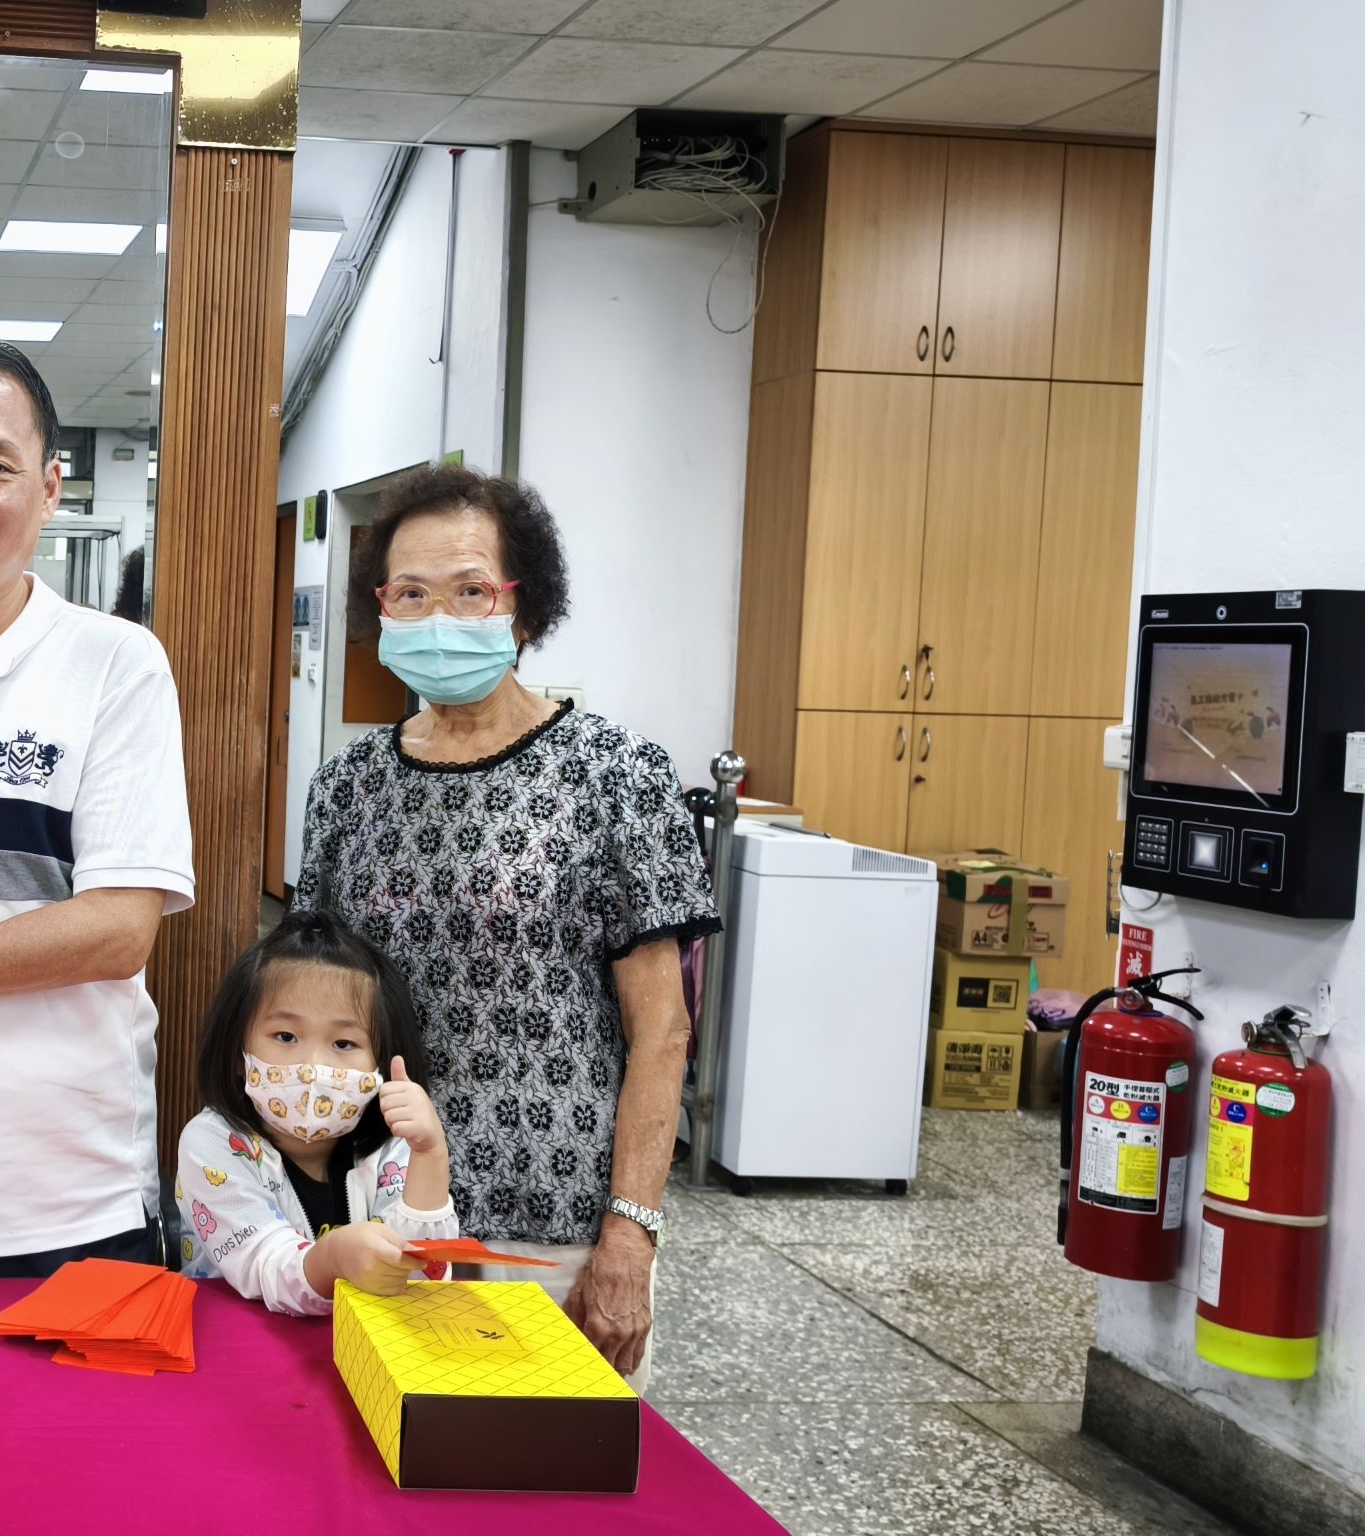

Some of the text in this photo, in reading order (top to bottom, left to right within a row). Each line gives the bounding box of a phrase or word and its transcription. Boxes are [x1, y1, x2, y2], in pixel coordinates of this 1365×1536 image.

[1128, 928, 1148, 941] FIRE
[1089, 1078, 1120, 1097] 20型
[213, 1224, 258, 1264] Dors bien
